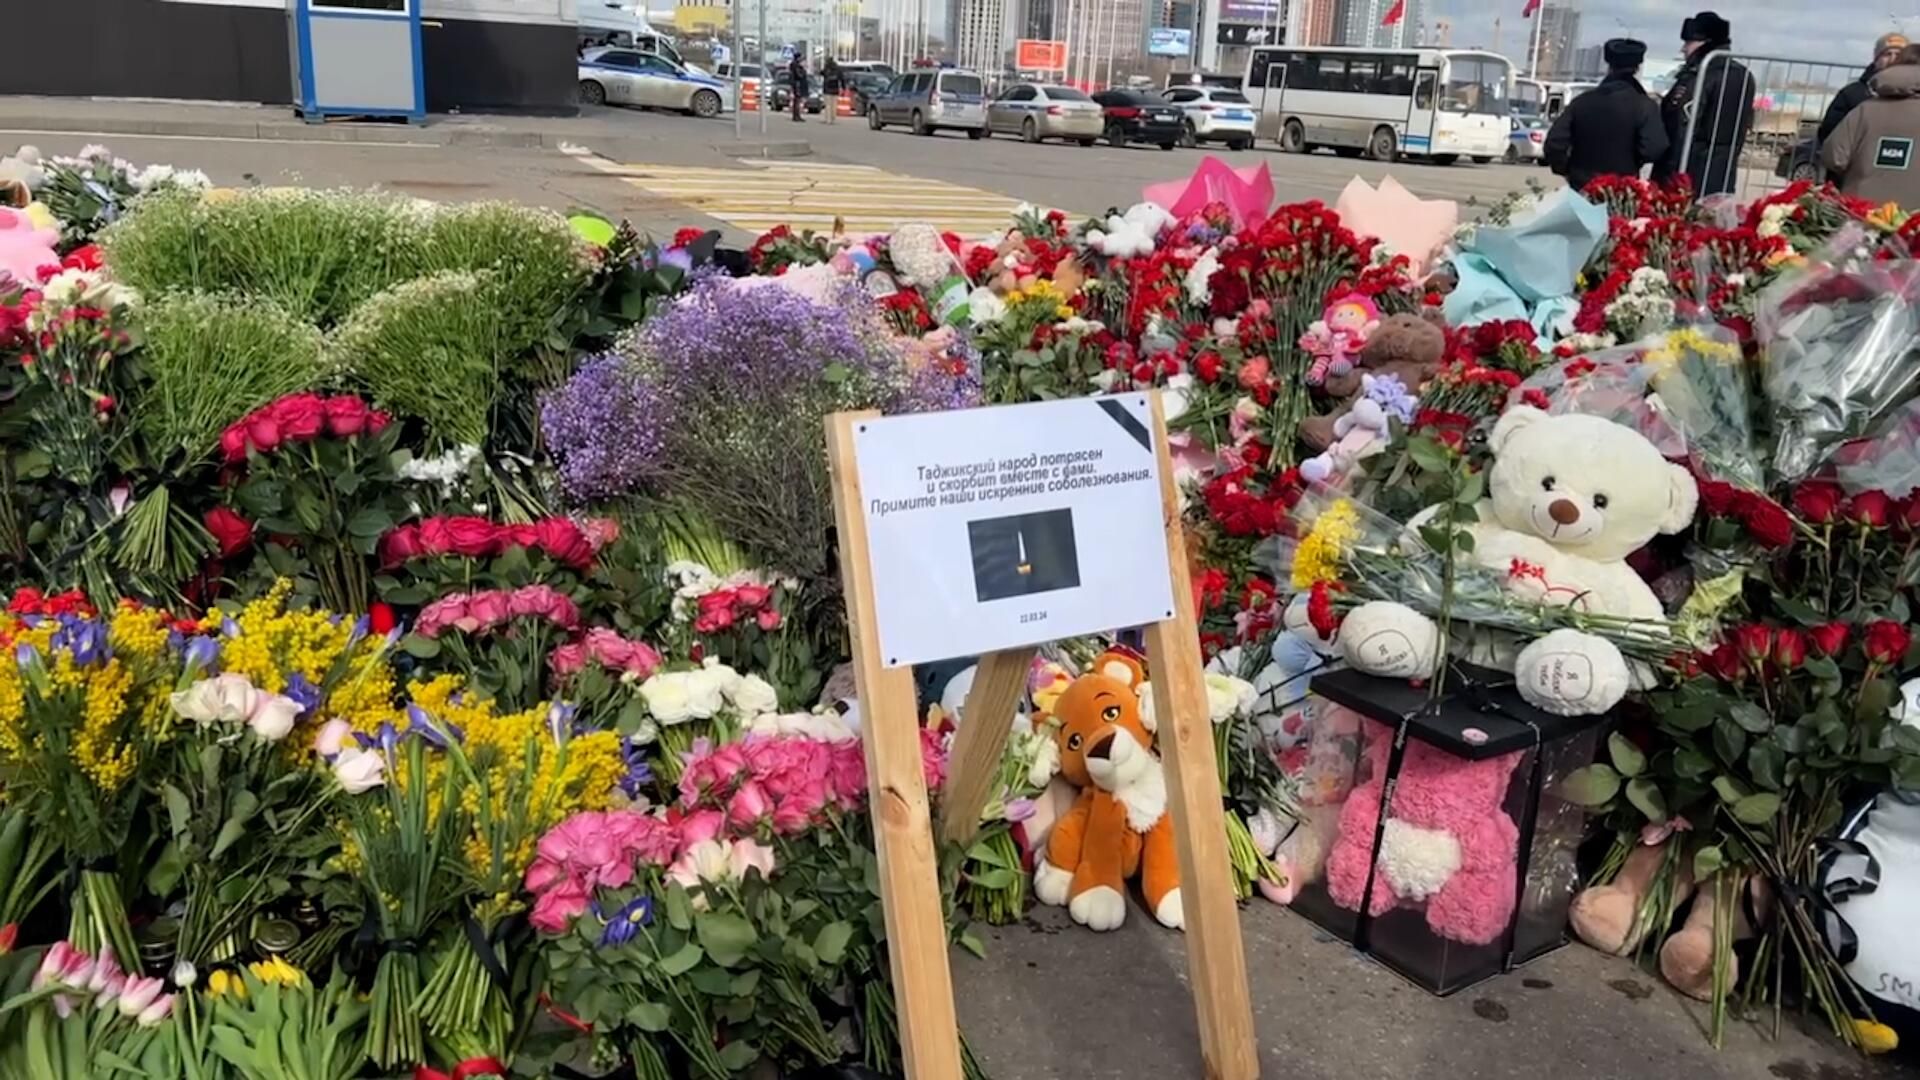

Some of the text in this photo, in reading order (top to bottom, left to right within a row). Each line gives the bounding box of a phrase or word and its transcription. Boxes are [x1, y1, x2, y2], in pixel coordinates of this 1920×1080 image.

[917, 449, 1102, 481] Таджикский народ потрясен
[927, 462, 1097, 494] и скорбит вместе с вами.
[871, 468, 1153, 516] Примите наши искренние соболезнования.
[1874, 972, 1920, 1001] SM
